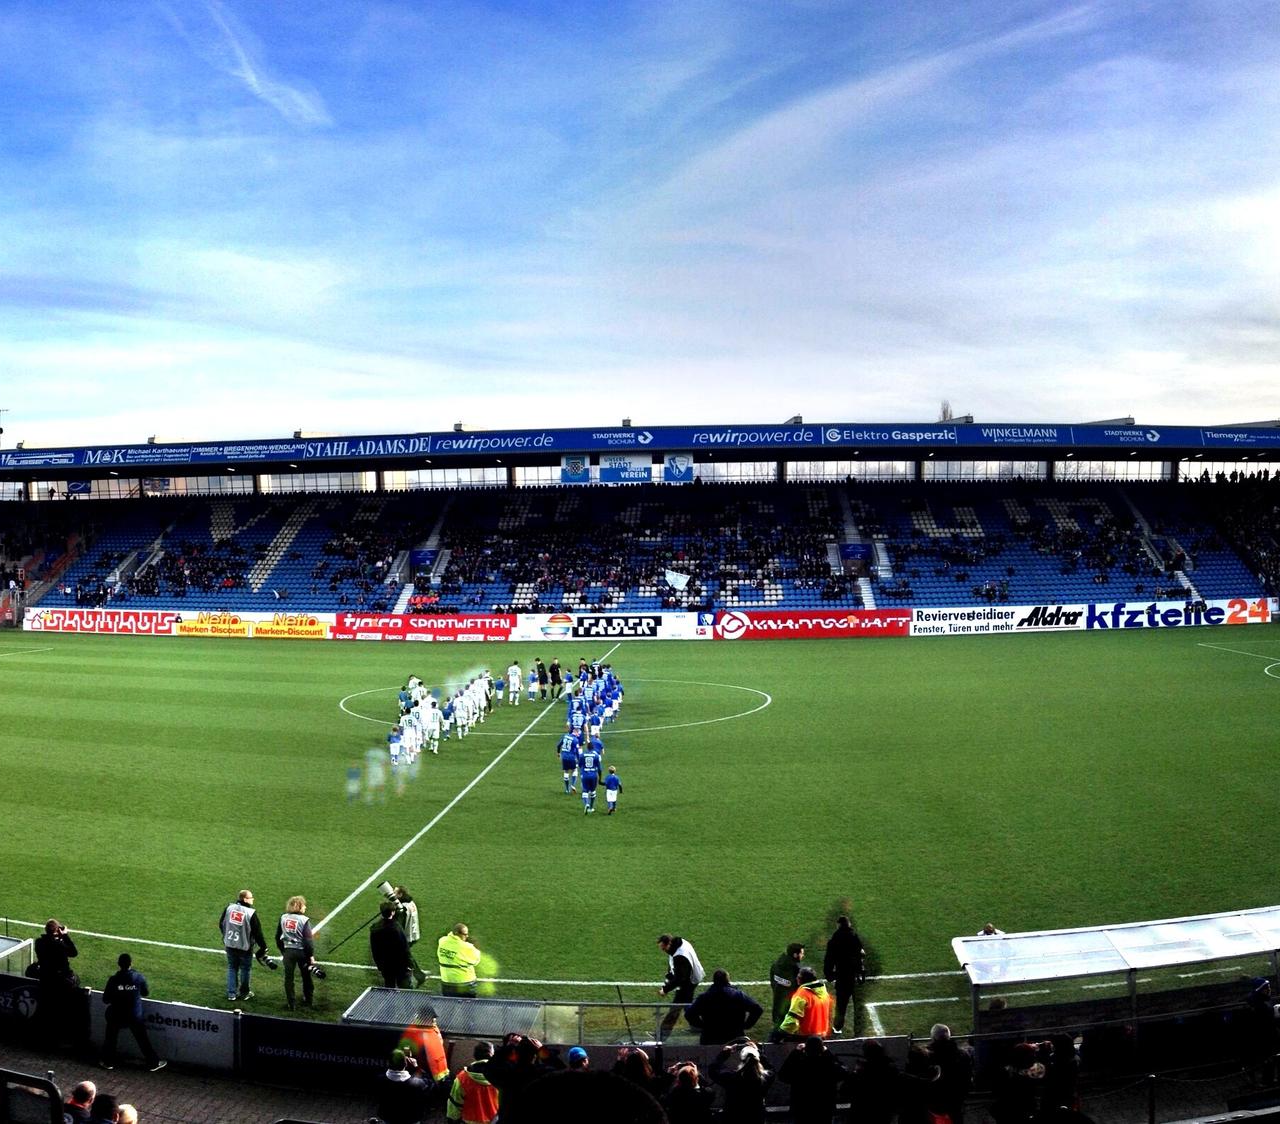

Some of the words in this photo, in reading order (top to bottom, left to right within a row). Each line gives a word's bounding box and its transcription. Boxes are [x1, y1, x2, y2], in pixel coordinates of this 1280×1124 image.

[592, 432, 635, 440] STADTWERKE
[692, 428, 813, 445] rewirpower.de
[843, 429, 889, 440] Elektro
[891, 429, 955, 442] Gasperzic
[981, 428, 1057, 440] WINKELMANN
[1205, 431, 1248, 441] Tiemeyer
[307, 437, 429, 457] STAHL-ADAMS.DE
[436, 433, 553, 451] rewirpower.de
[620, 471, 648, 479] VEREIN
[197, 612, 241, 625] Netto
[273, 613, 319, 626] Netto
[409, 618, 510, 629] SPORTWETTEN
[255, 626, 324, 636] Marken-Discount
[578, 618, 655, 635] FABER
[913, 623, 945, 634] Fenster,
[948, 622, 971, 633] Türen
[974, 622, 991, 632] und
[993, 621, 1014, 632] mehr
[227, 930, 240, 941] 25
[147, 1013, 220, 1033] ebenshilfe
